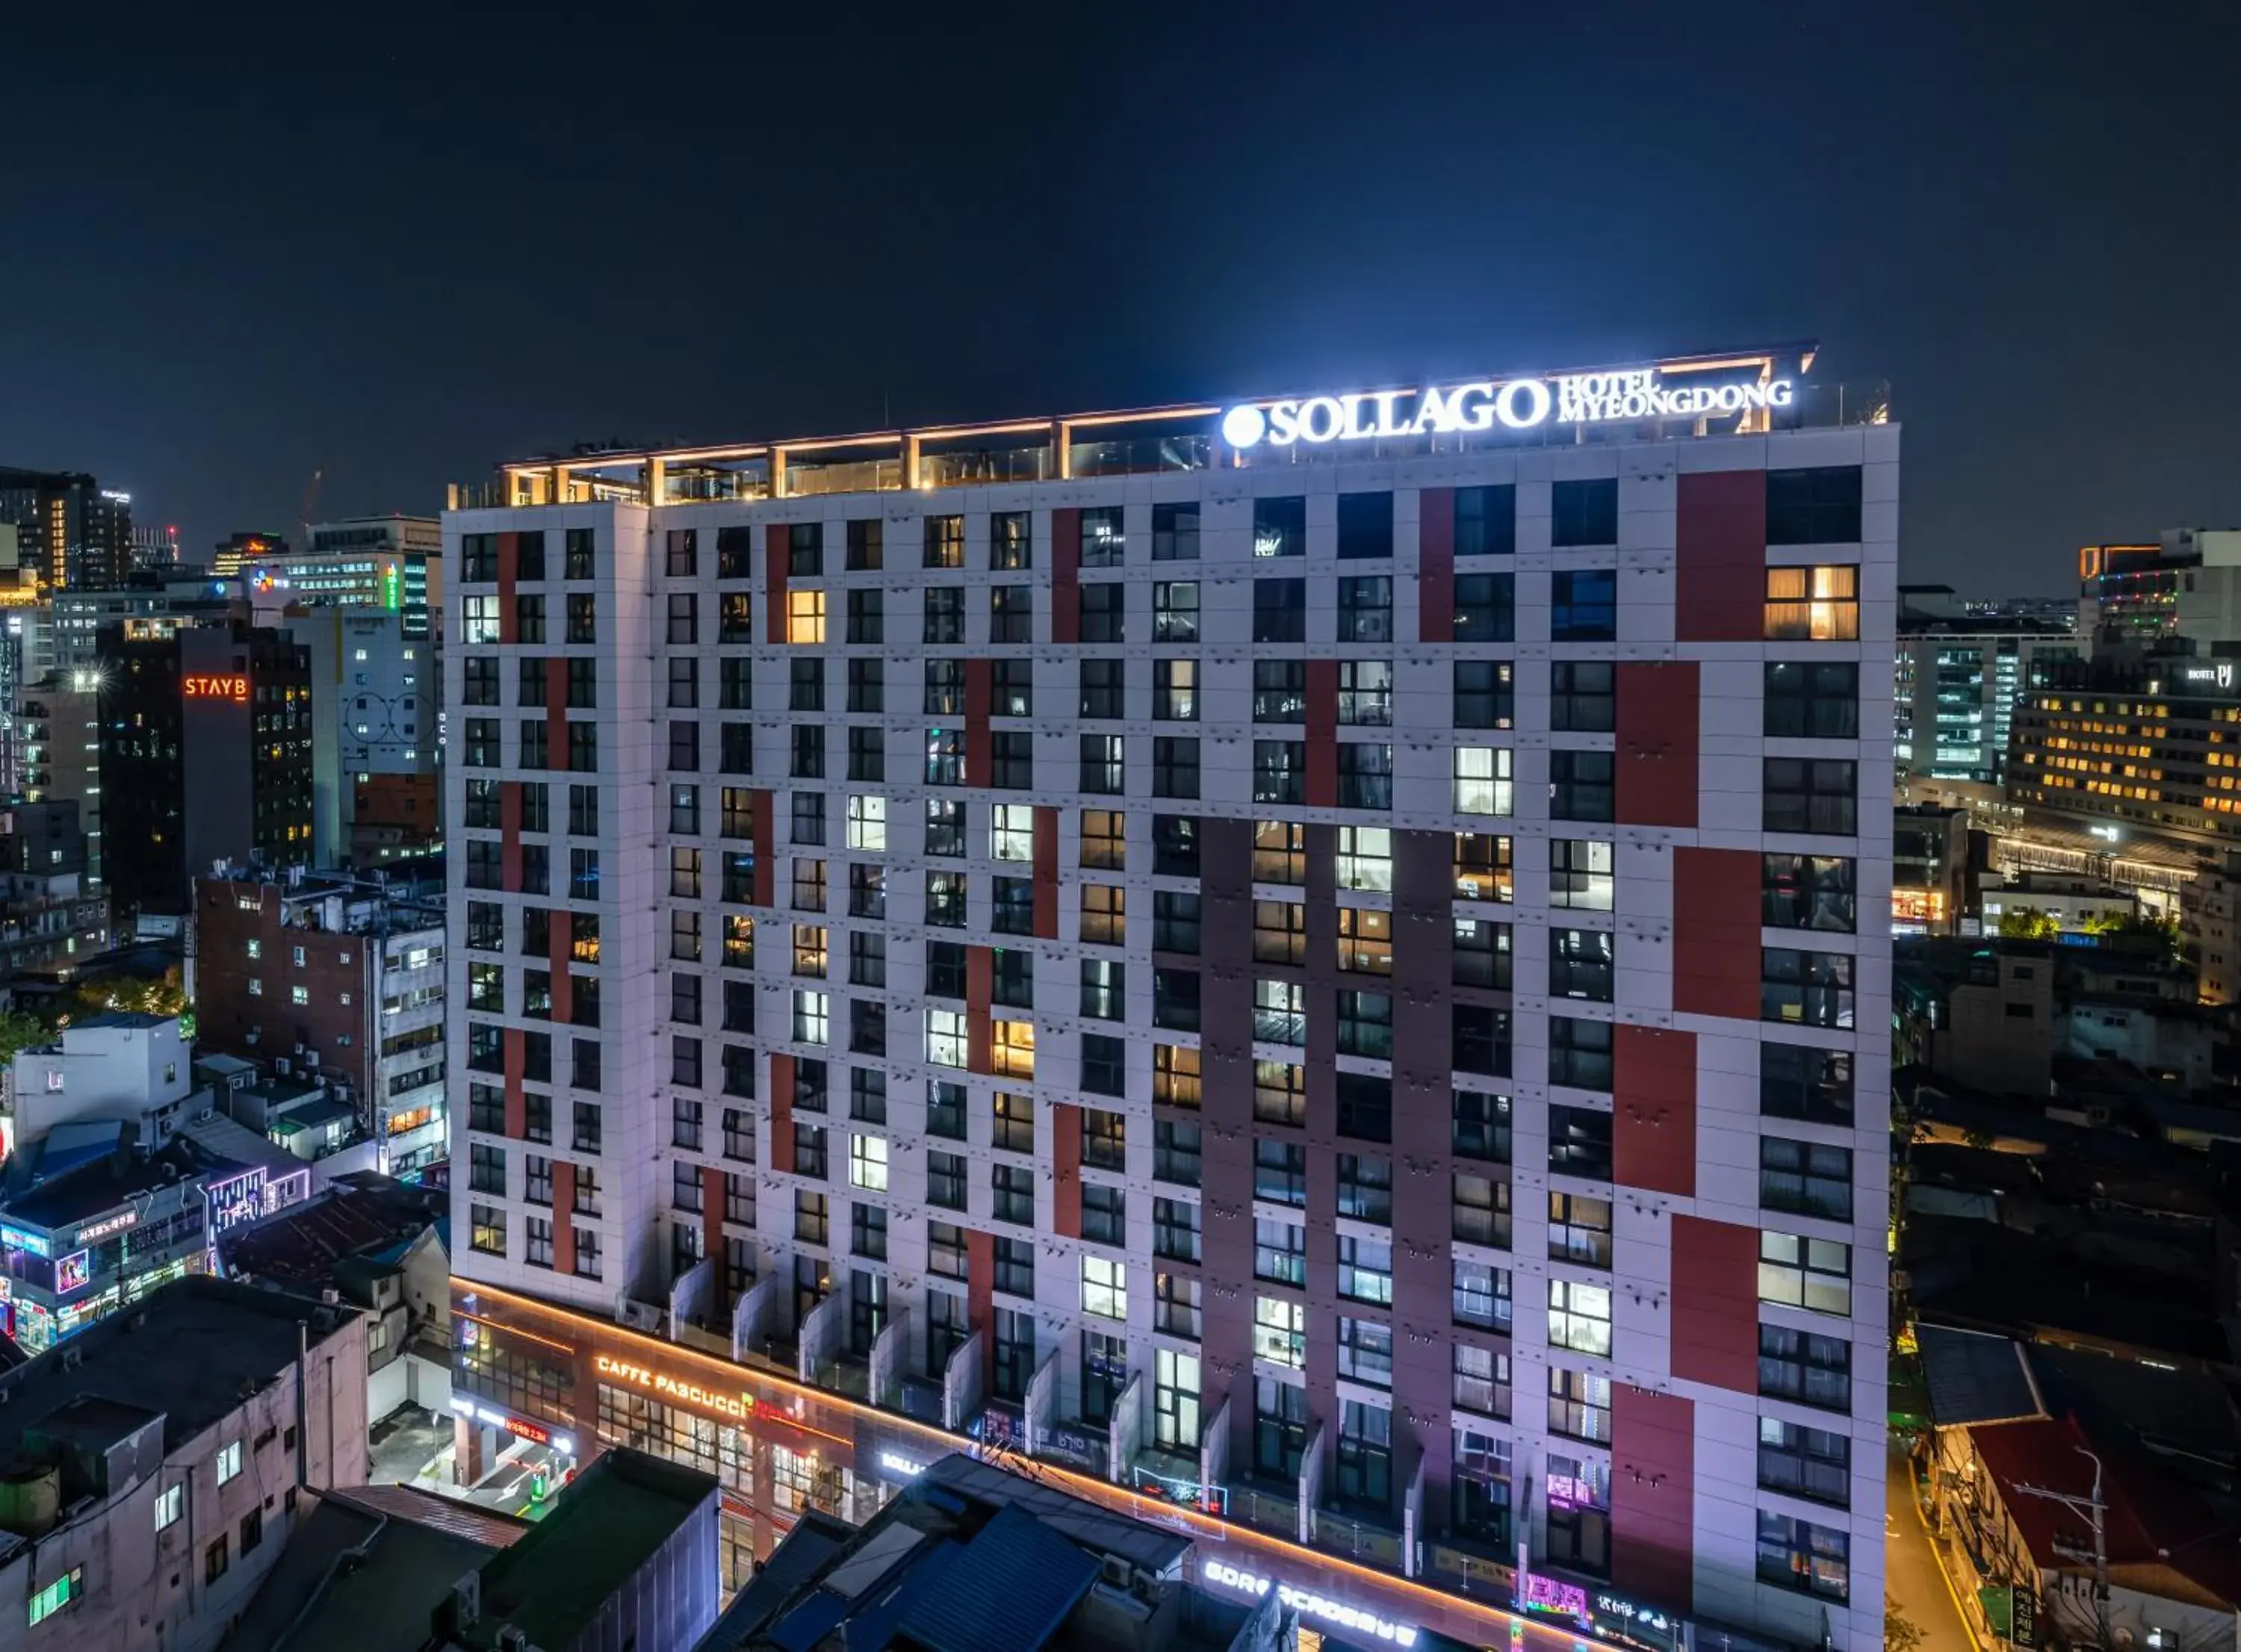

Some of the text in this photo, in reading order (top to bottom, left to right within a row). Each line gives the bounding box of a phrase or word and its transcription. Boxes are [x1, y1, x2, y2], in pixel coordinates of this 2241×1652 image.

[1557, 380, 1792, 422] MYEONGDONG
[1558, 370, 1661, 400] HOTEL
[1268, 379, 1551, 447] SOLLAGO
[185, 678, 247, 696] STAYB
[598, 1356, 651, 1386] CAFFE
[654, 1375, 746, 1418] PASCUCCI
